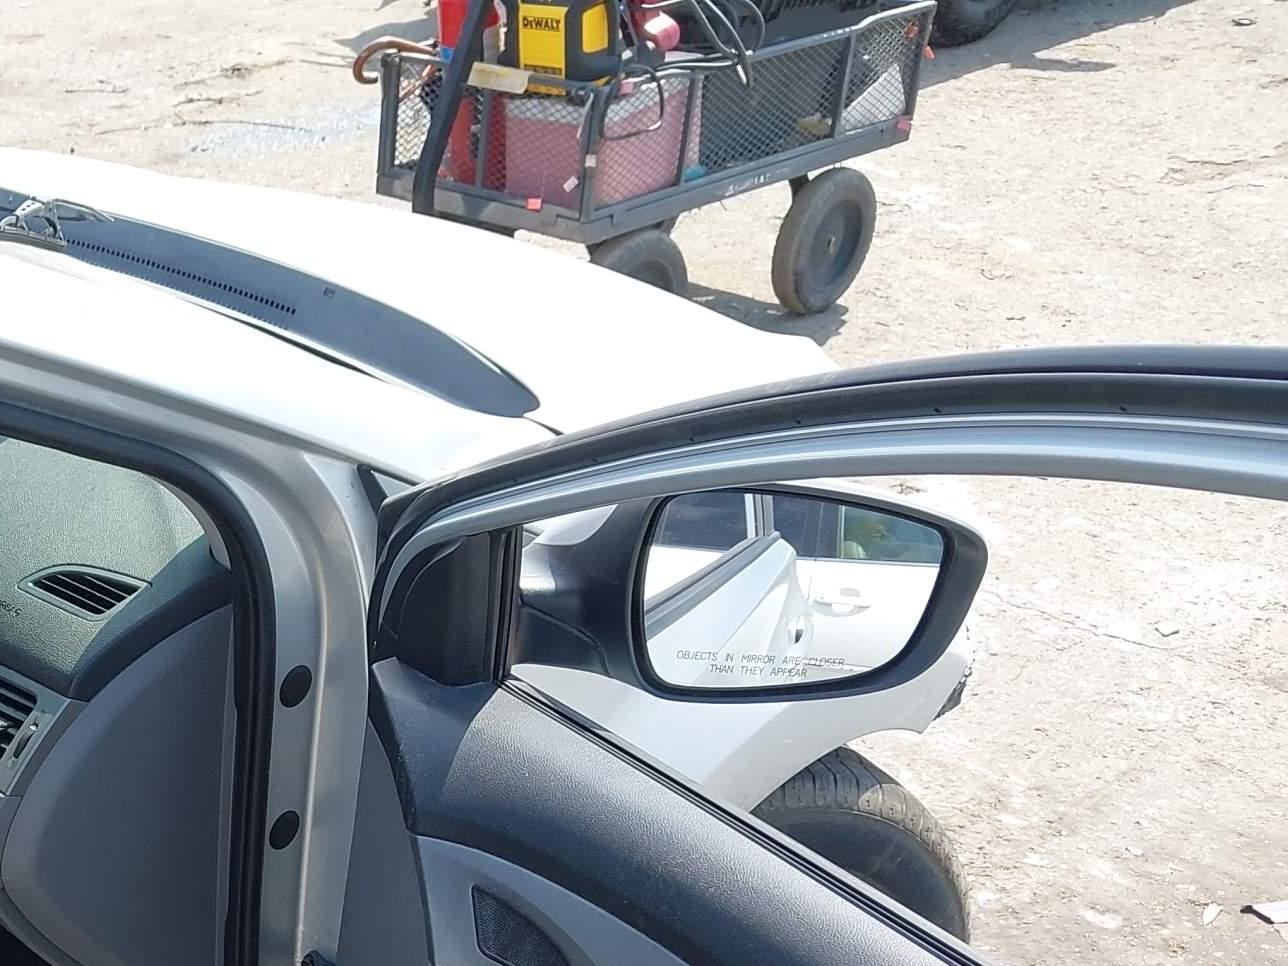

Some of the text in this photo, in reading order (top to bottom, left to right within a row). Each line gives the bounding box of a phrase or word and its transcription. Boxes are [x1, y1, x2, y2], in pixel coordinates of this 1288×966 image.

[676, 650, 845, 667] OBJECTS IN MIRROR ARE CLOSER
[710, 664, 808, 677] THAN THEY APPEAR
